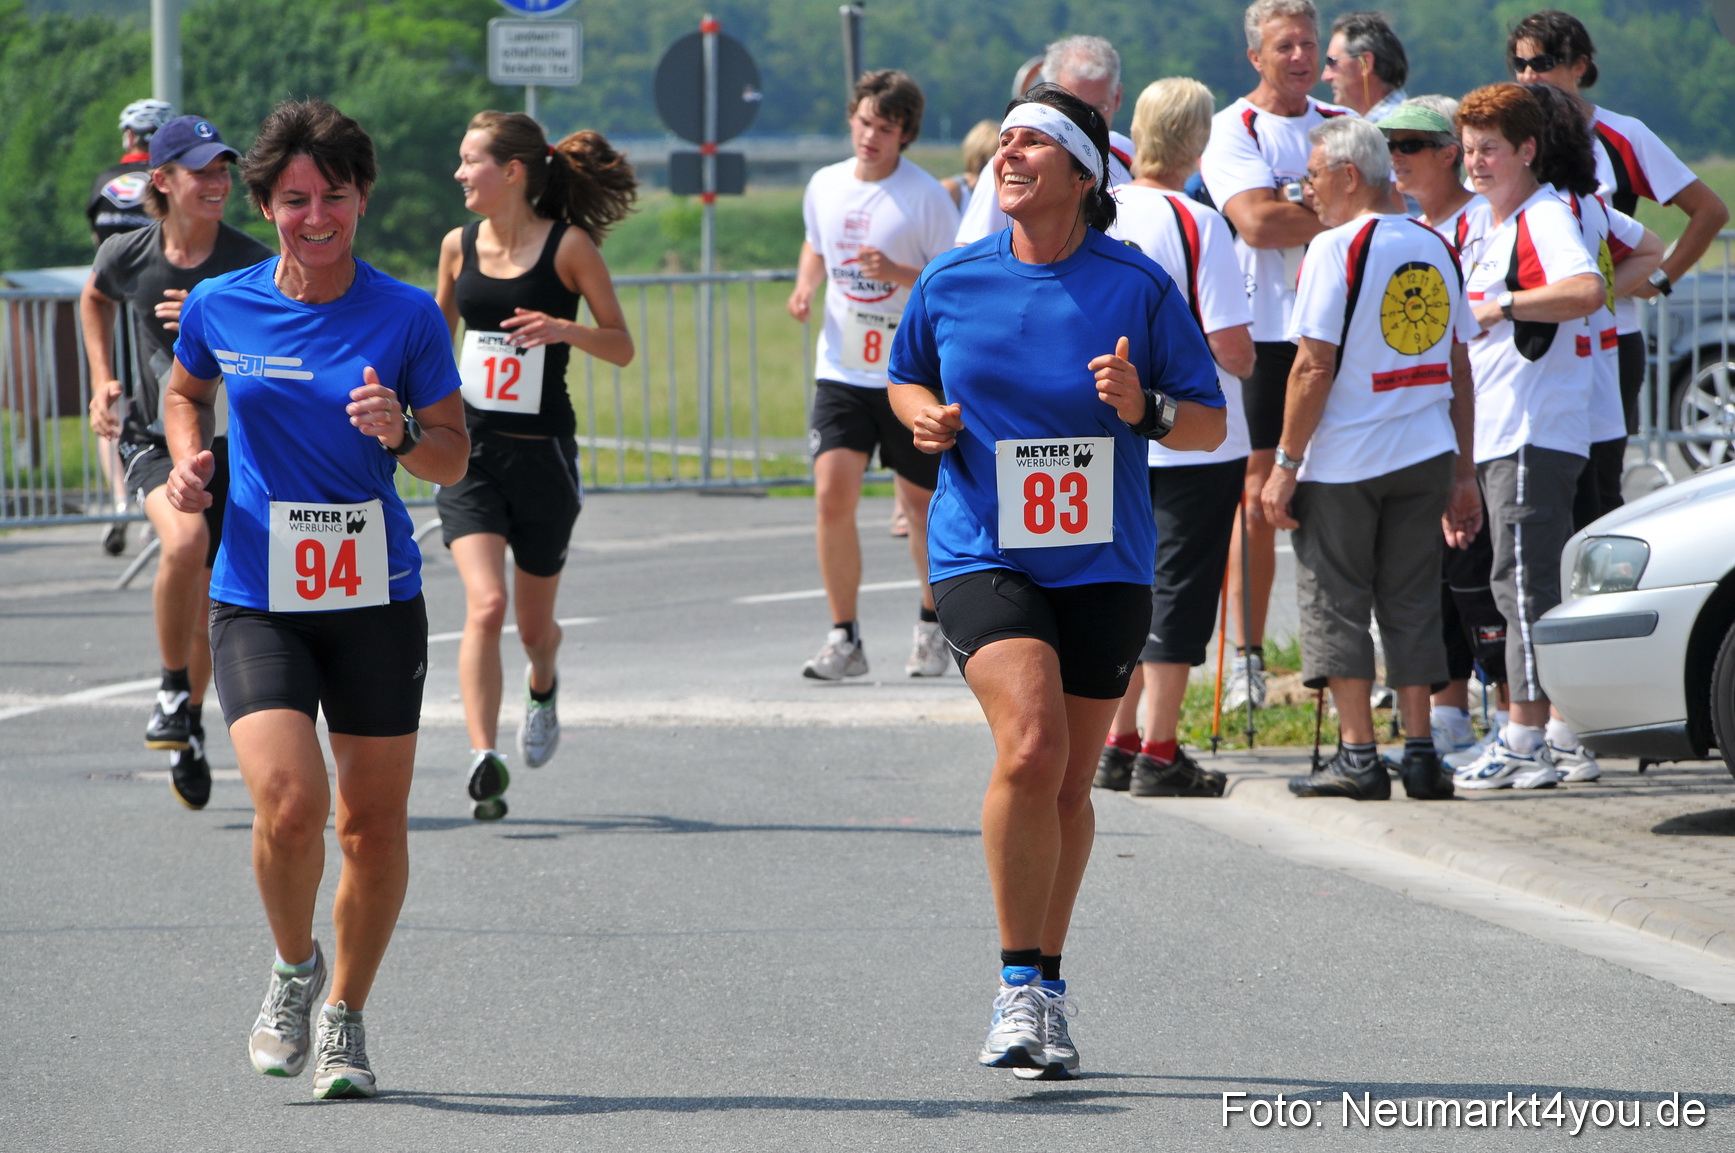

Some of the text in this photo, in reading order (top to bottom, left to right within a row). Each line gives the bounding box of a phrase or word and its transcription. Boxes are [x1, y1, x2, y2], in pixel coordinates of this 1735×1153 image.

[864, 329, 882, 363] 8
[483, 356, 521, 401] 12
[1015, 444, 1070, 458] MEYER
[1016, 457, 1071, 467] WERBUNG
[1023, 472, 1089, 534] 83
[289, 509, 342, 523] MEYER
[289, 522, 343, 533] WERBUNG
[295, 538, 362, 601] 94
